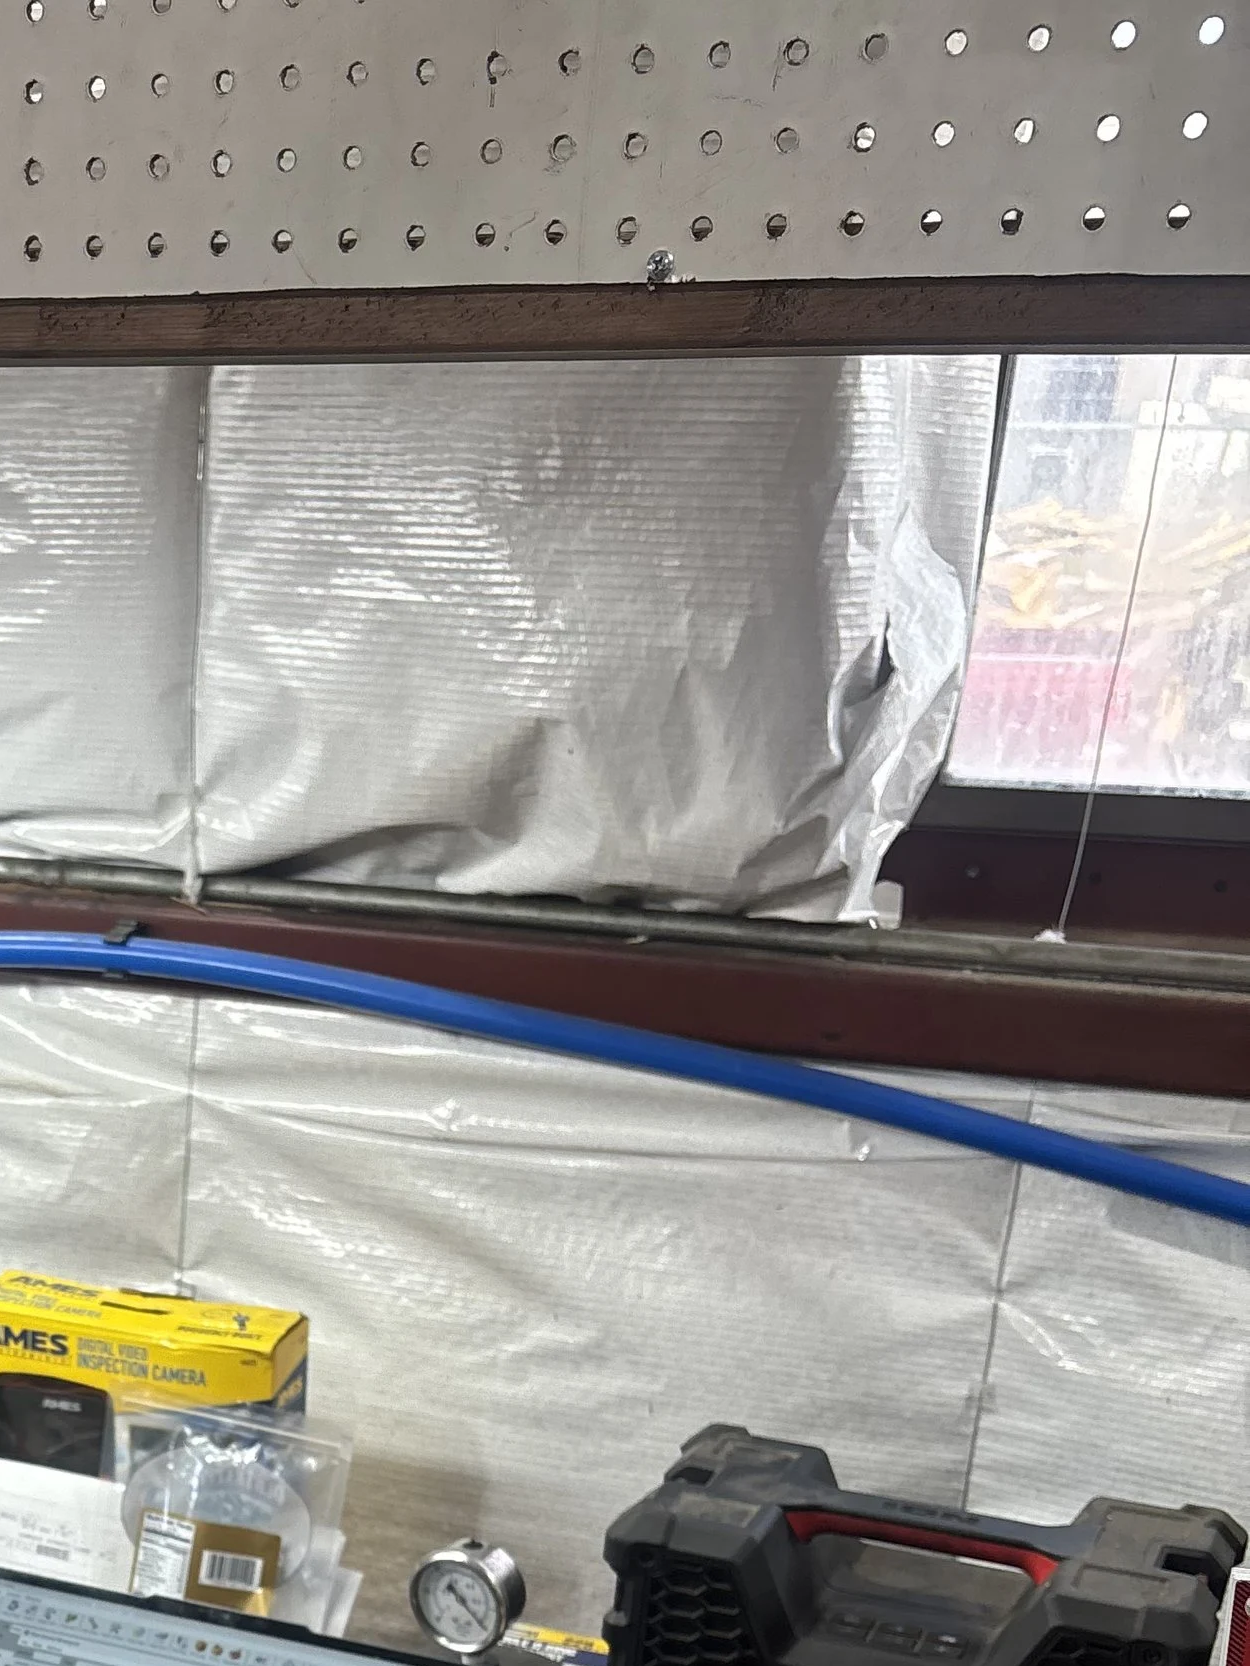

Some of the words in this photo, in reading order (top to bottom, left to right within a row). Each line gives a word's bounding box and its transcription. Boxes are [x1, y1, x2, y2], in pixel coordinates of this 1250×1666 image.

[76, 1337, 115, 1357] DIGITAL
[117, 1342, 149, 1361] VIDEO
[76, 1354, 148, 1379] INSPECTION
[152, 1363, 207, 1387] CAMERA
[42, 1398, 82, 1412] AMES
